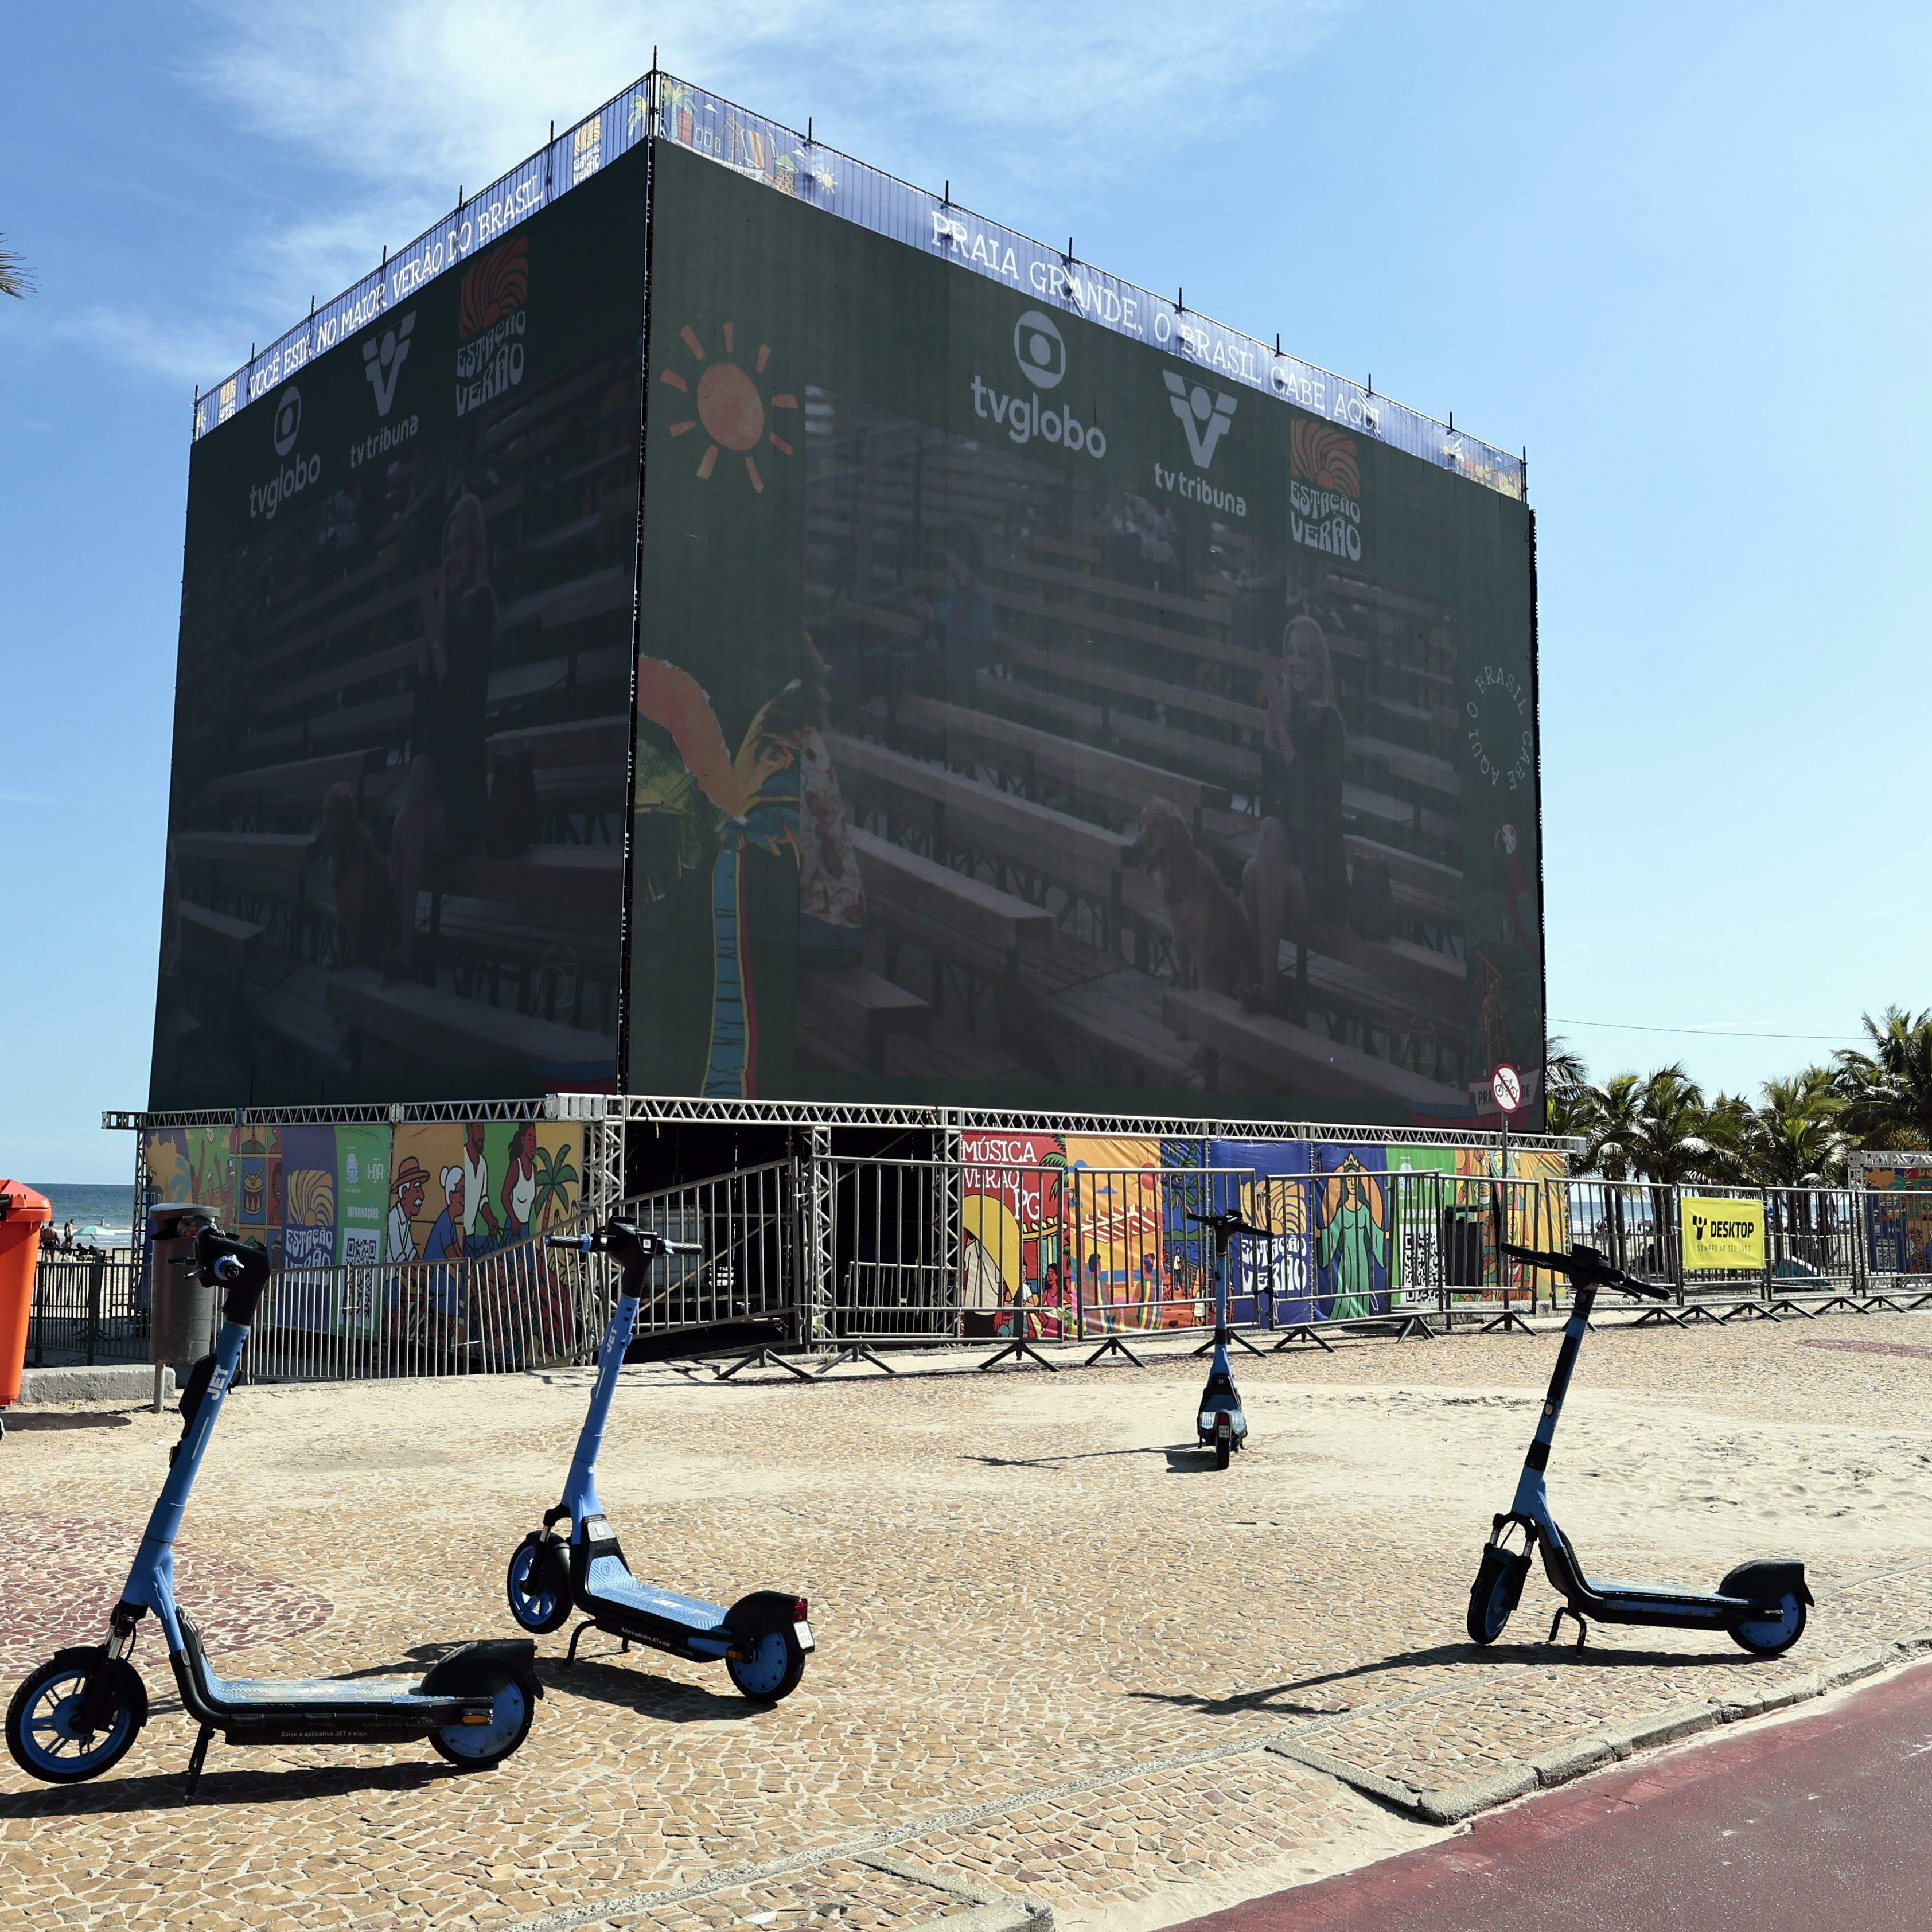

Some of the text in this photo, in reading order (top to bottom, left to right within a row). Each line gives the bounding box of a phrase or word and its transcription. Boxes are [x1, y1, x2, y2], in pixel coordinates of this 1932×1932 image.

[250, 174, 543, 399] VOCÊ ESTÁ NO MAIOR VERÃO DO BRASIL
[457, 310, 526, 378] ESTAÇÃO
[932, 211, 1381, 434] PRAIA GRANDE, O BRASIL CABE AQUI
[456, 341, 524, 418] VERÃO
[367, 414, 418, 459] tribuna
[971, 375, 1107, 458] tvglobo
[250, 454, 321, 519] tvglobo
[1178, 473, 1247, 517] tribuna
[1290, 480, 1360, 524] ESTAÇÃO
[1290, 509, 1361, 562] VERÃO
[1467, 666, 1533, 790] O BRASIL CABE AQUI
[961, 1136, 1037, 1163] MÚSICA
[286, 1226, 333, 1258] ESTAÇÃO
[1241, 1234, 1307, 1267] ESTAÇÃO
[1710, 1221, 1754, 1238] DESKTOP
[1242, 1254, 1307, 1292] VERÃO
[606, 1325, 618, 1353] JET
[207, 1364, 228, 1400] JET
